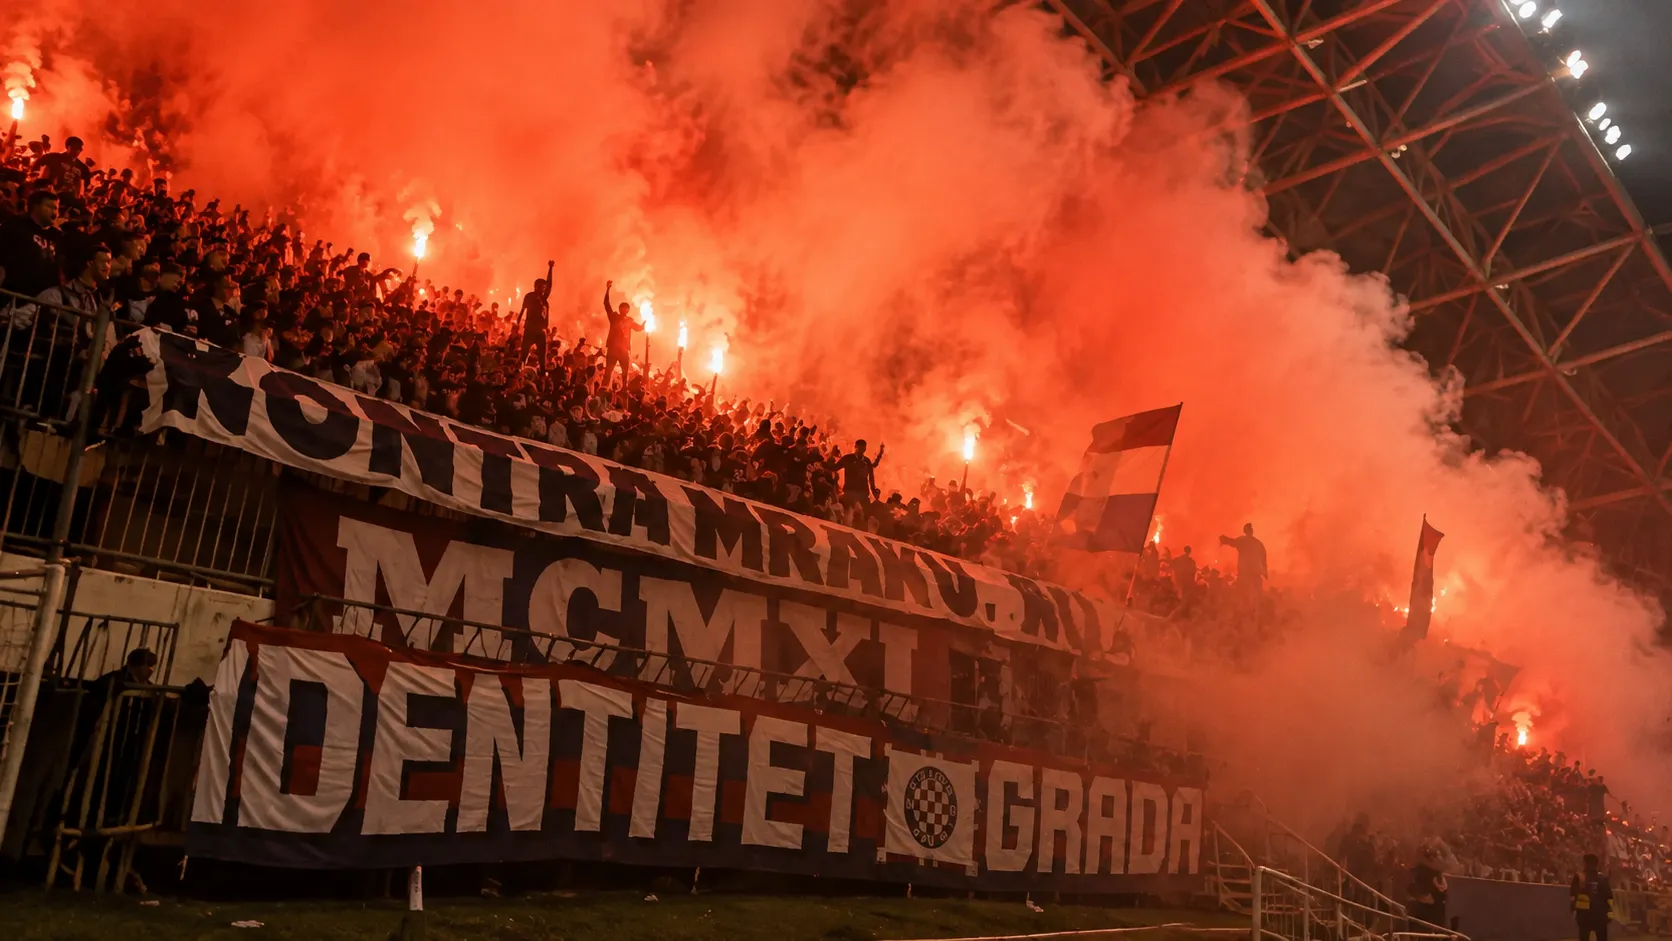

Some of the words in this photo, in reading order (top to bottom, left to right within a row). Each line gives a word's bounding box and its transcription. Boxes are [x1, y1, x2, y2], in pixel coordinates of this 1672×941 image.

[159, 333, 671, 546] KONTRA
[681, 482, 978, 618] MRAKU
[332, 515, 919, 722] MCMXI
[190, 638, 872, 854] IDENTITET
[985, 759, 1204, 876] GRADA
